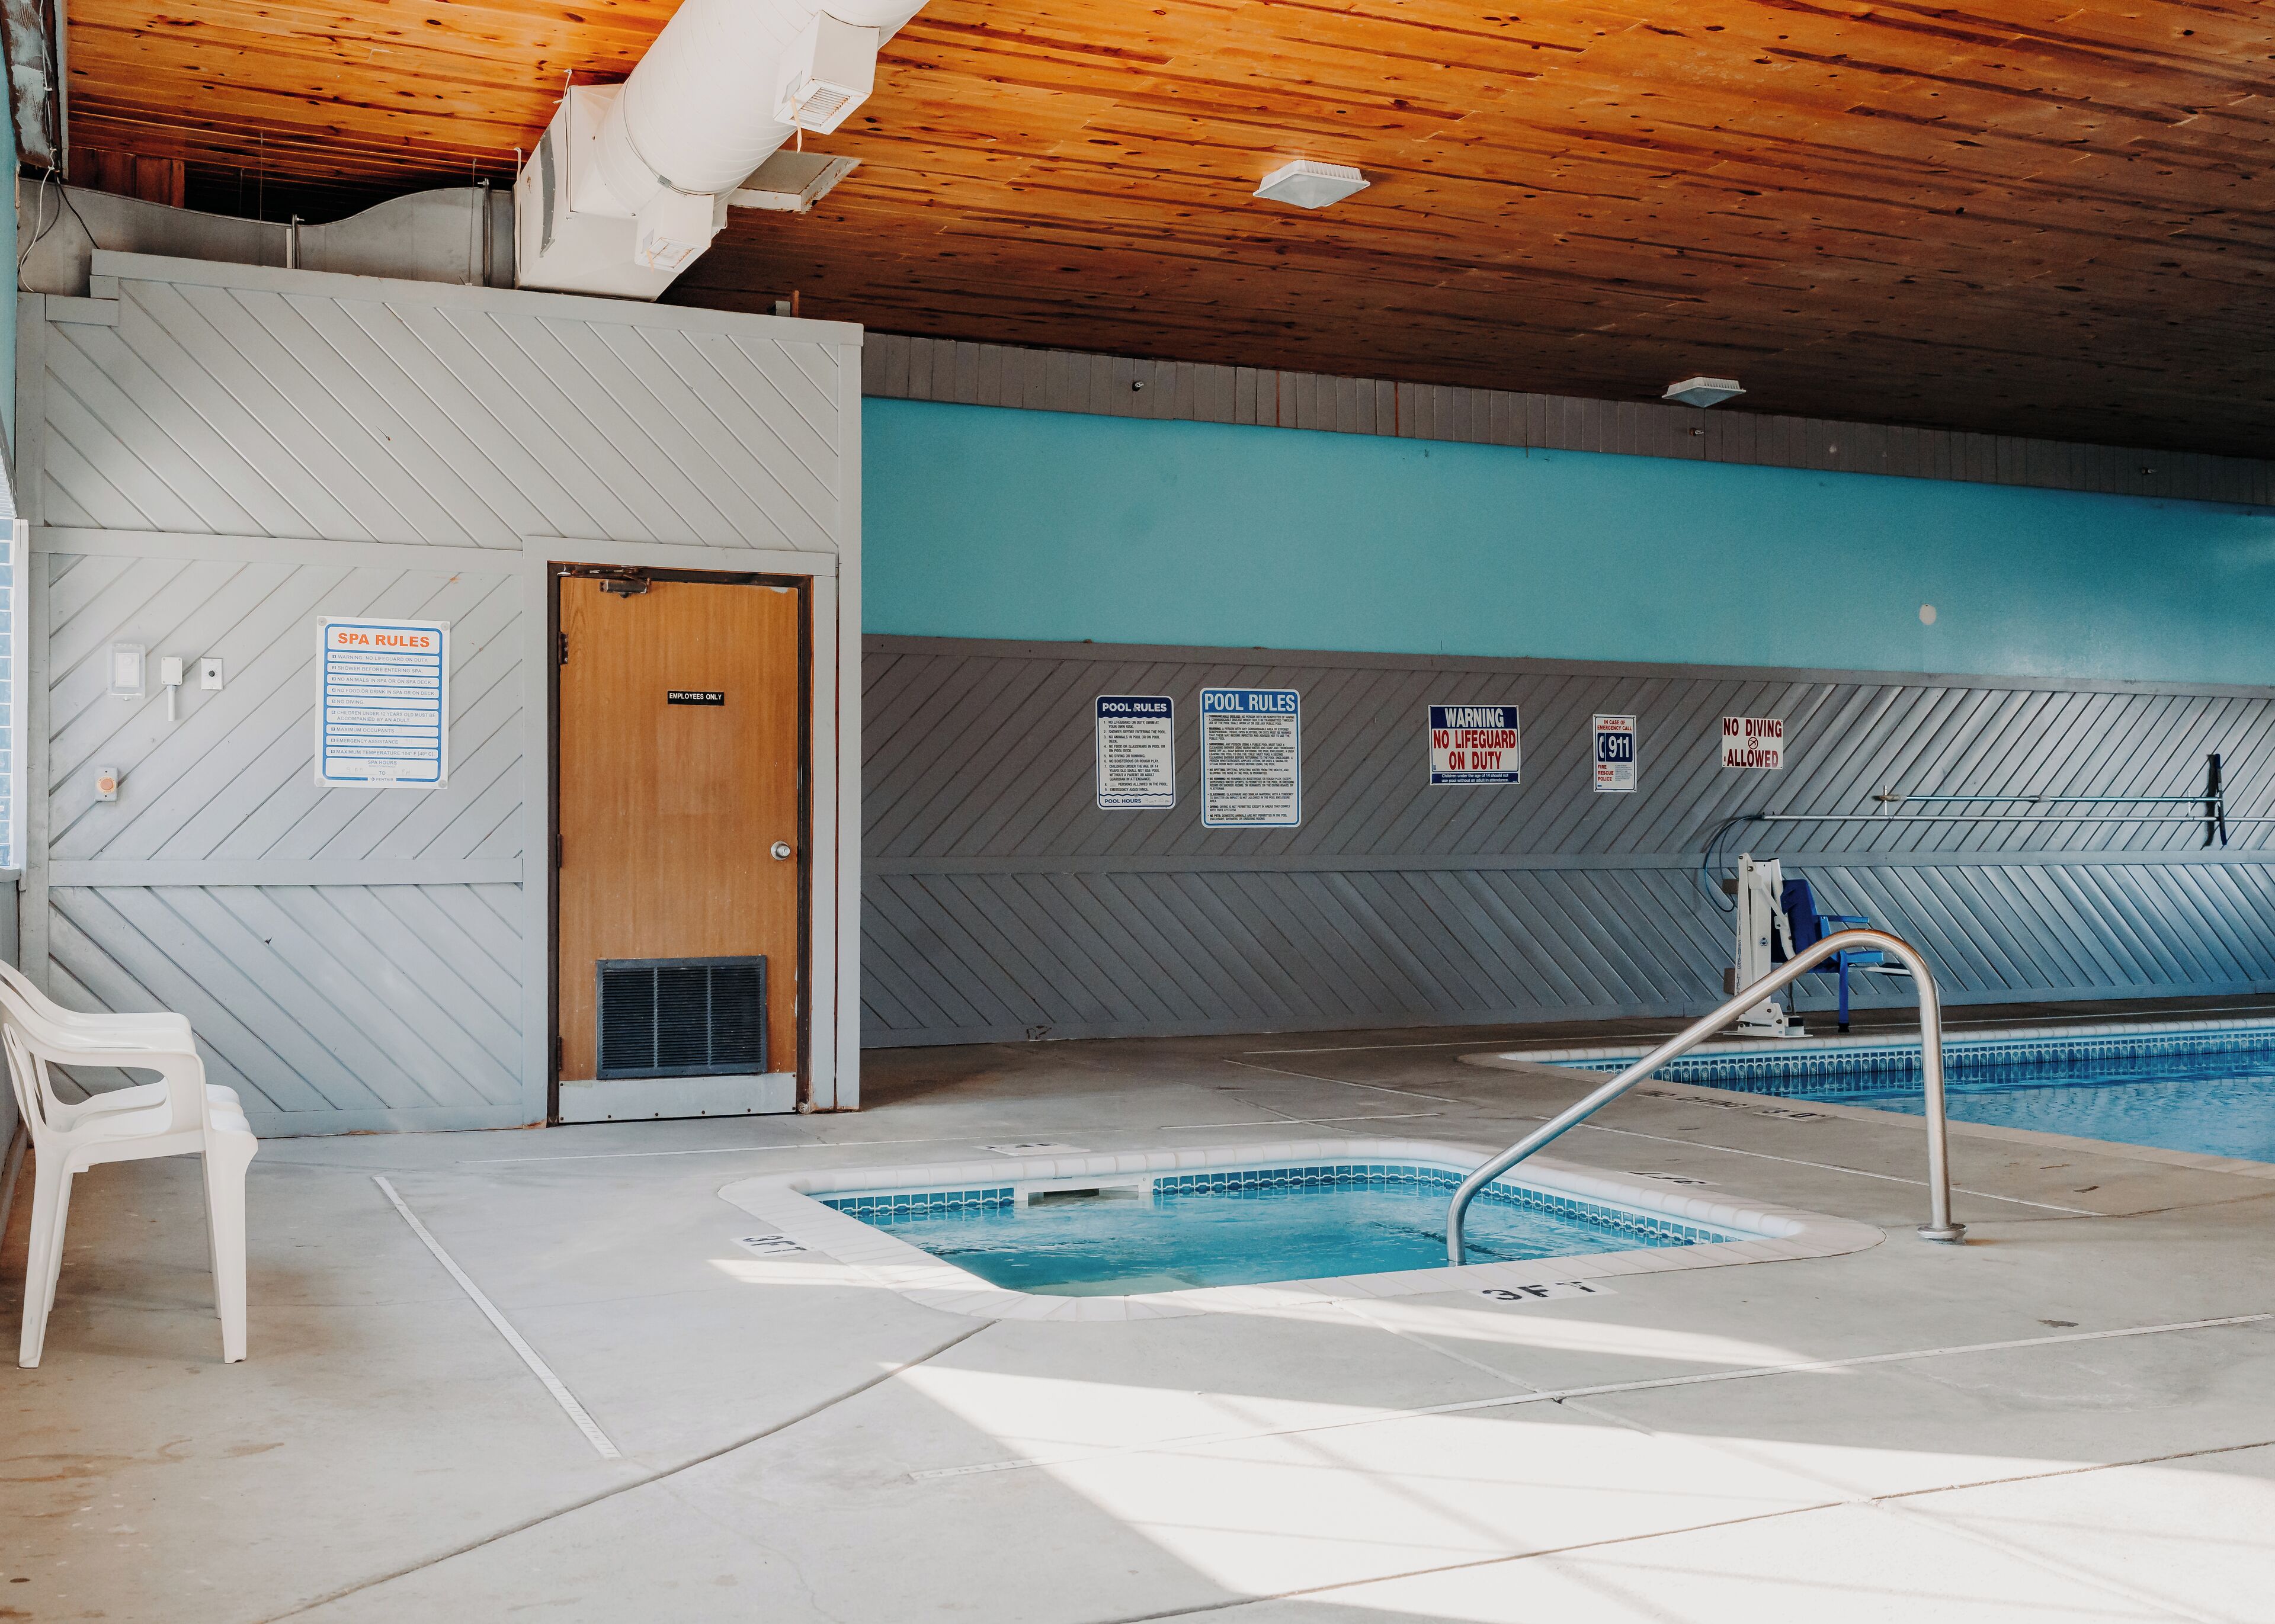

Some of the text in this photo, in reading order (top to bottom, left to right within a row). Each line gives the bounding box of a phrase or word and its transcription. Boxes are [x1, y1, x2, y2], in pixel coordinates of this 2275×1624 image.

[338, 633, 430, 647] SPA RULES
[1103, 702, 1167, 712] POOL RULES
[1205, 693, 1295, 711] POOL RULES
[1445, 708, 1504, 727] WARNING
[1723, 718, 1782, 738] NO DIVING
[1434, 730, 1515, 749] NO LIFEGUARD
[1608, 736, 1629, 758] 911
[1449, 751, 1502, 770] ON DUTY
[1727, 749, 1779, 768] ALLOWED
